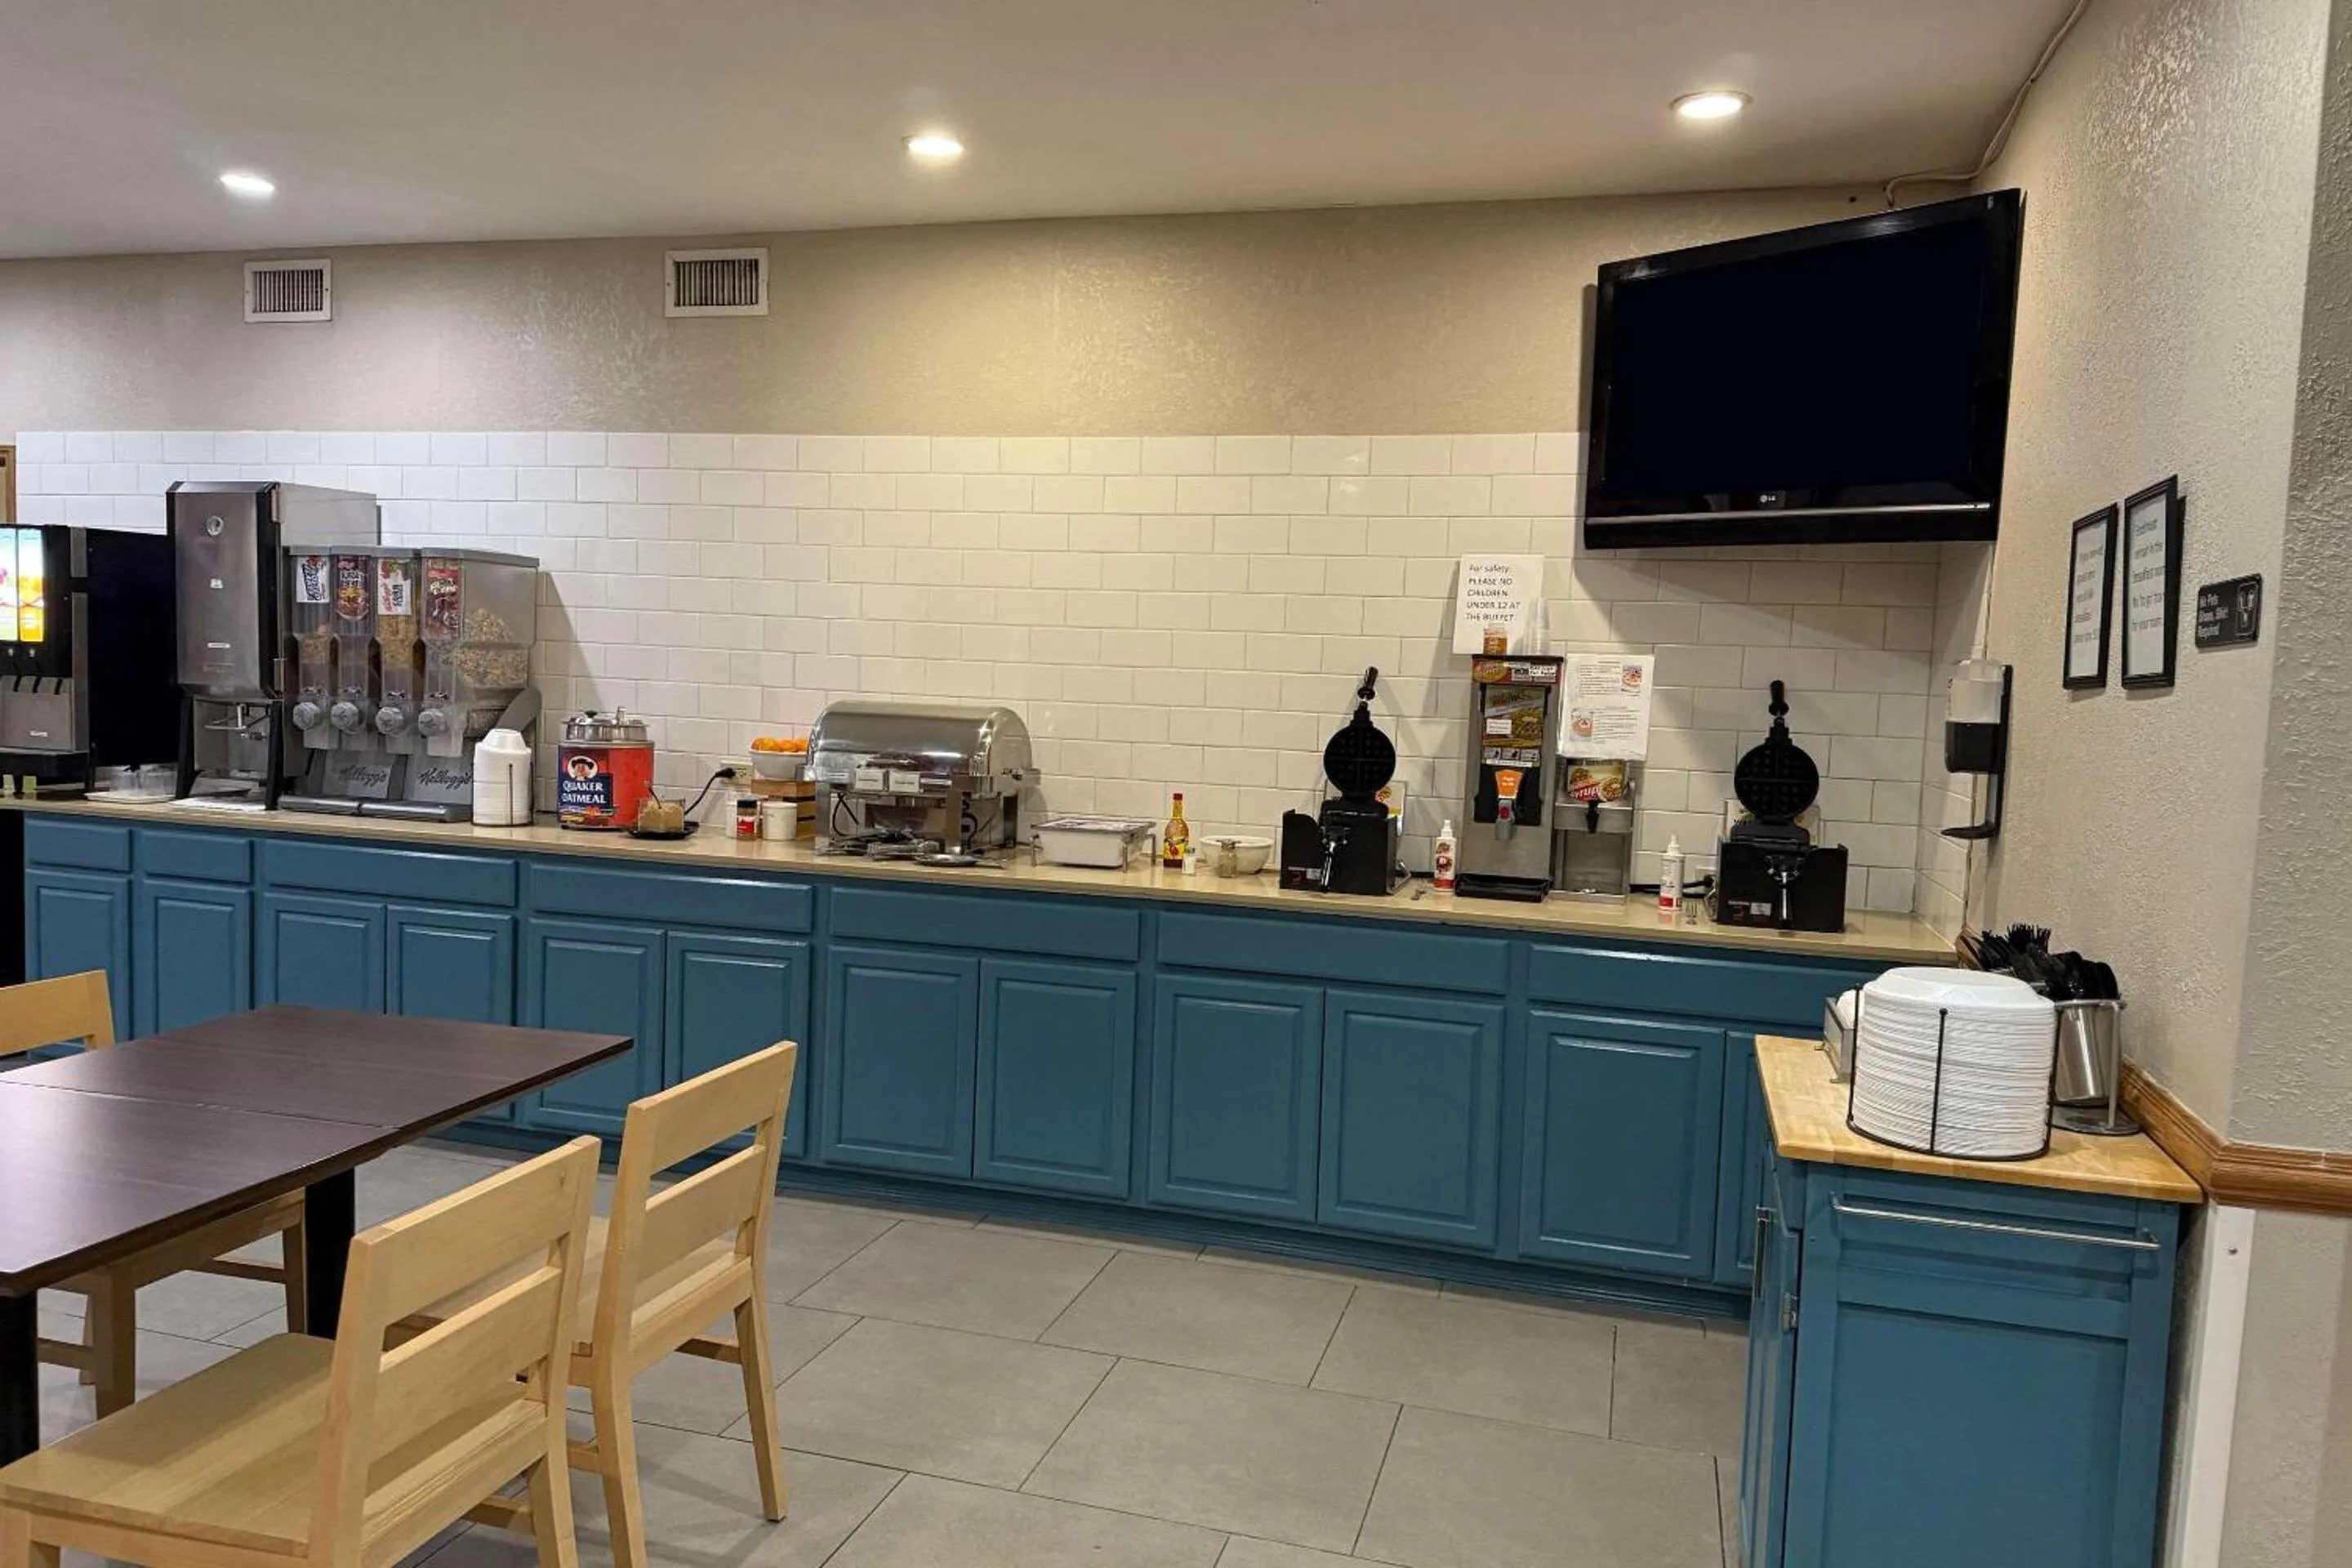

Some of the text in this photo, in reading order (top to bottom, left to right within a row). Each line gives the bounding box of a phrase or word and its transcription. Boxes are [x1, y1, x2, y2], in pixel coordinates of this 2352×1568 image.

[1469, 564, 1483, 572] For
[1468, 577, 1513, 586] PLEASE NO
[1467, 589, 1508, 597] CHILDREN
[1466, 601, 1521, 609] UNDER 12 AT
[1466, 612, 1514, 621] THE BUFFET
[562, 780, 604, 792] QUAKER
[561, 793, 608, 804] OATMEAL
